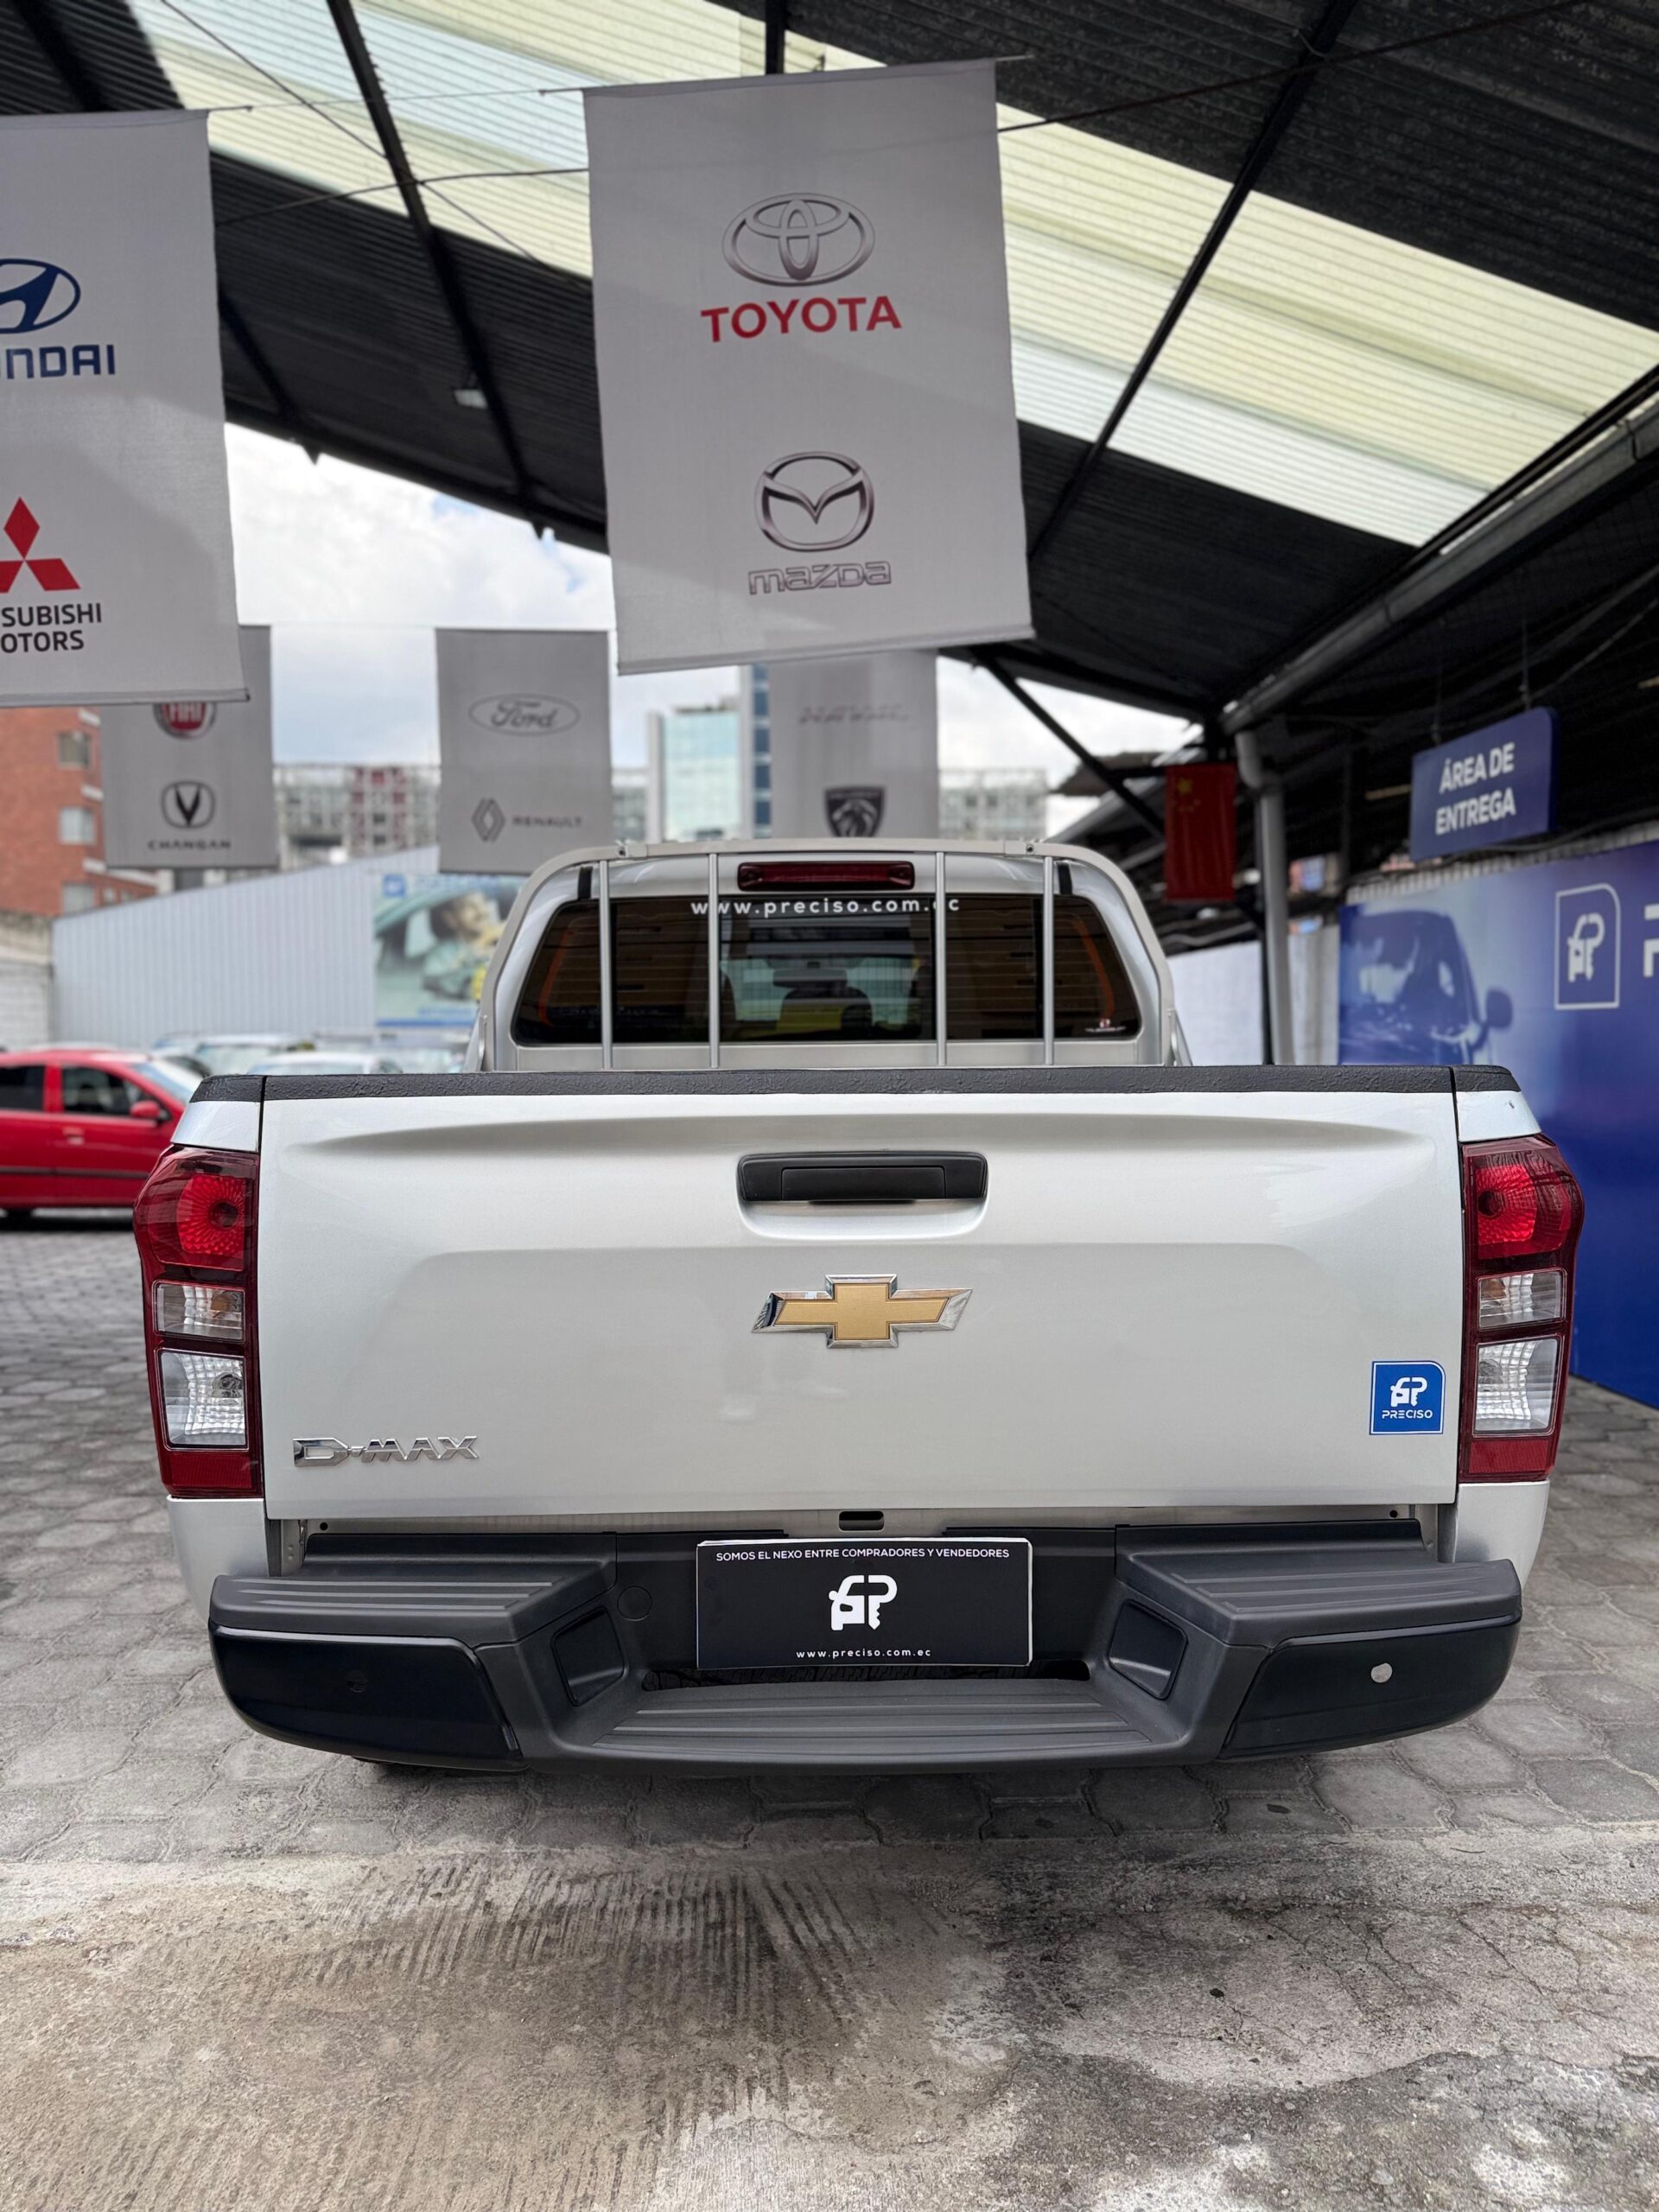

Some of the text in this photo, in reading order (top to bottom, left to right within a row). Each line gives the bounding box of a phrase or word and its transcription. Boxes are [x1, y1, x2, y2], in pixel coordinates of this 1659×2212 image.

[701, 296, 902, 343] TOYOTA
[0, 345, 116, 379] NDAI
[1, 603, 102, 627] SUBISHI
[0, 630, 84, 653] OTORS
[490, 701, 558, 728] Ford
[1439, 742, 1515, 794] ÁREA DE
[1435, 787, 1516, 836] ENTREGA
[147, 839, 232, 851] CHANGAN
[691, 898, 959, 918] www.preciso.com.c
[1382, 1409, 1433, 1419] PRECISO
[716, 1548, 1009, 1560] SOMOS EL NEXO ENTRE COMPRADORES Y VENDEDORES
[796, 1648, 931, 1659] www.preciso.com.ec
